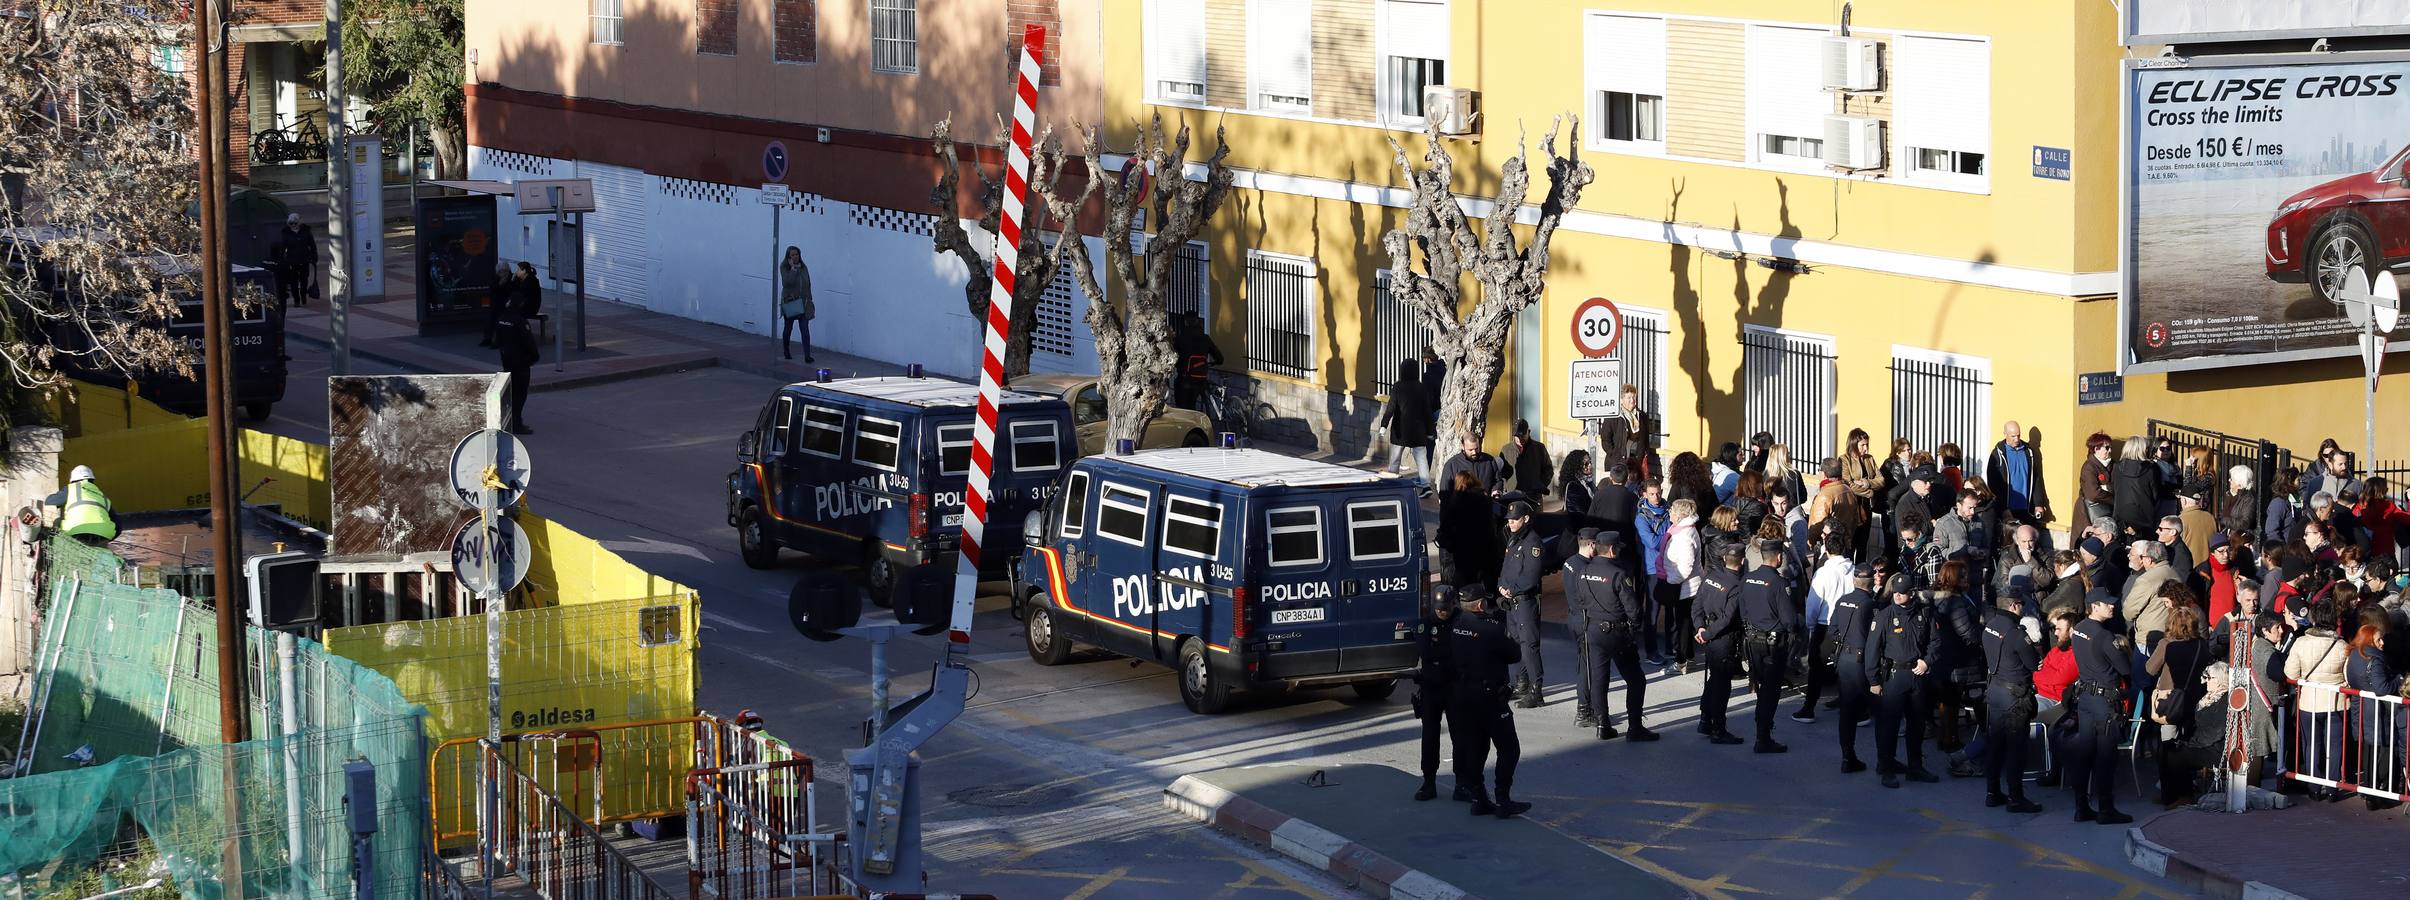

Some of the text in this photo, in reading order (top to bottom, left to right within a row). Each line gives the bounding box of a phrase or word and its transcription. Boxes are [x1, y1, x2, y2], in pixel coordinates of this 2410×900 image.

[2148, 74, 2403, 104] ECLIPSE CROSS
[2148, 105, 2283, 126] Cross the limits
[2044, 151, 2068, 162] CALLE
[2148, 144, 2192, 160] Desde
[2196, 138, 2227, 158] 150
[2232, 137, 2243, 156] €
[2256, 143, 2283, 156] mes
[2034, 166, 2048, 176] TORRE
[2049, 166, 2056, 177] DE
[1584, 318, 1611, 337] 30
[2152, 330, 2160, 340] 5
[234, 336, 262, 346] 3 U-23
[2093, 376, 2119, 386] CALLE
[1584, 385, 1608, 394] ZONA
[1576, 400, 1616, 408] ESCOLAR
[890, 474, 909, 490] 3 U-26
[815, 474, 893, 522] POLICIA
[1032, 487, 1039, 500] 3
[1210, 564, 1234, 581] 3 U-25
[1112, 564, 1210, 618] POLICIA
[1262, 581, 1332, 603] POLICIA
[1368, 577, 1408, 593] 3 U-25
[528, 708, 595, 728] aldesa
